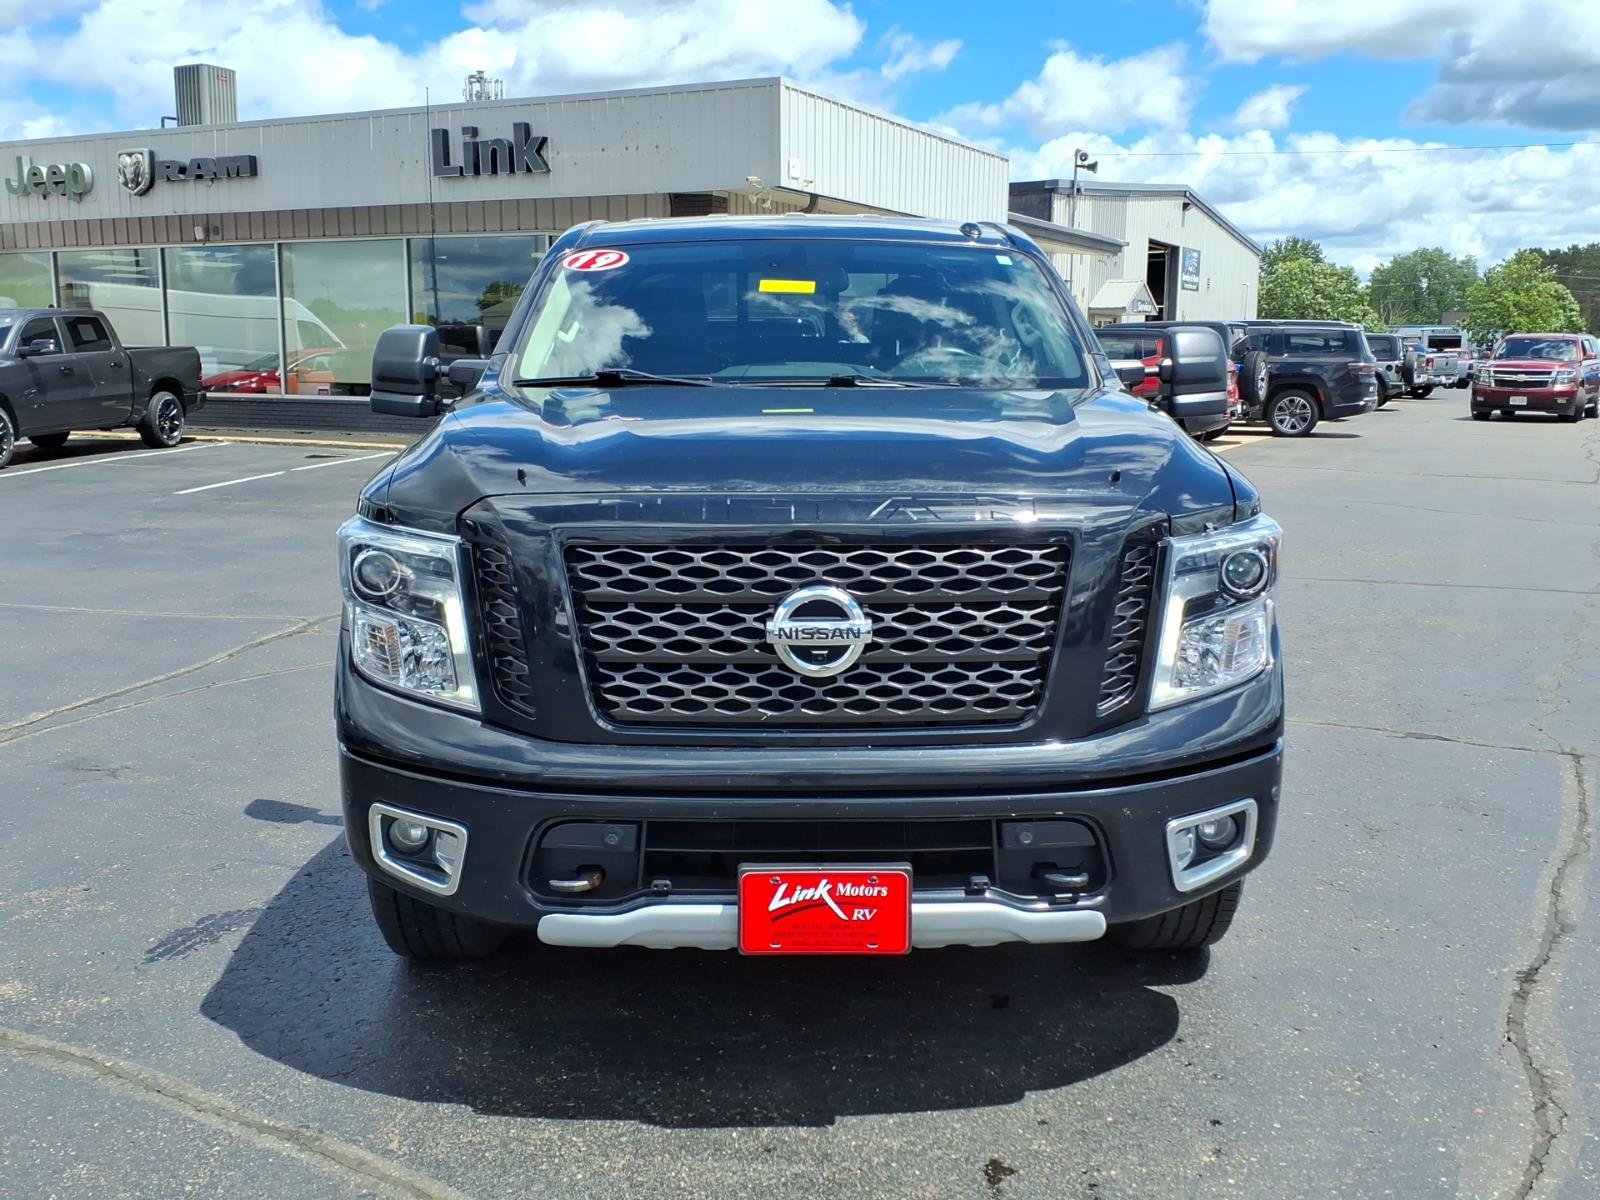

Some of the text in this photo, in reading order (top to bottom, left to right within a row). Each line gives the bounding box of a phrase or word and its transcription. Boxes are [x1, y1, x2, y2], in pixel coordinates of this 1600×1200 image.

[431, 122, 552, 177] Link
[5, 155, 94, 203] Jeep
[155, 155, 258, 181] RAM
[778, 627, 861, 640] NISSAN
[768, 879, 888, 921] Link Motors
[852, 908, 878, 921] RV
